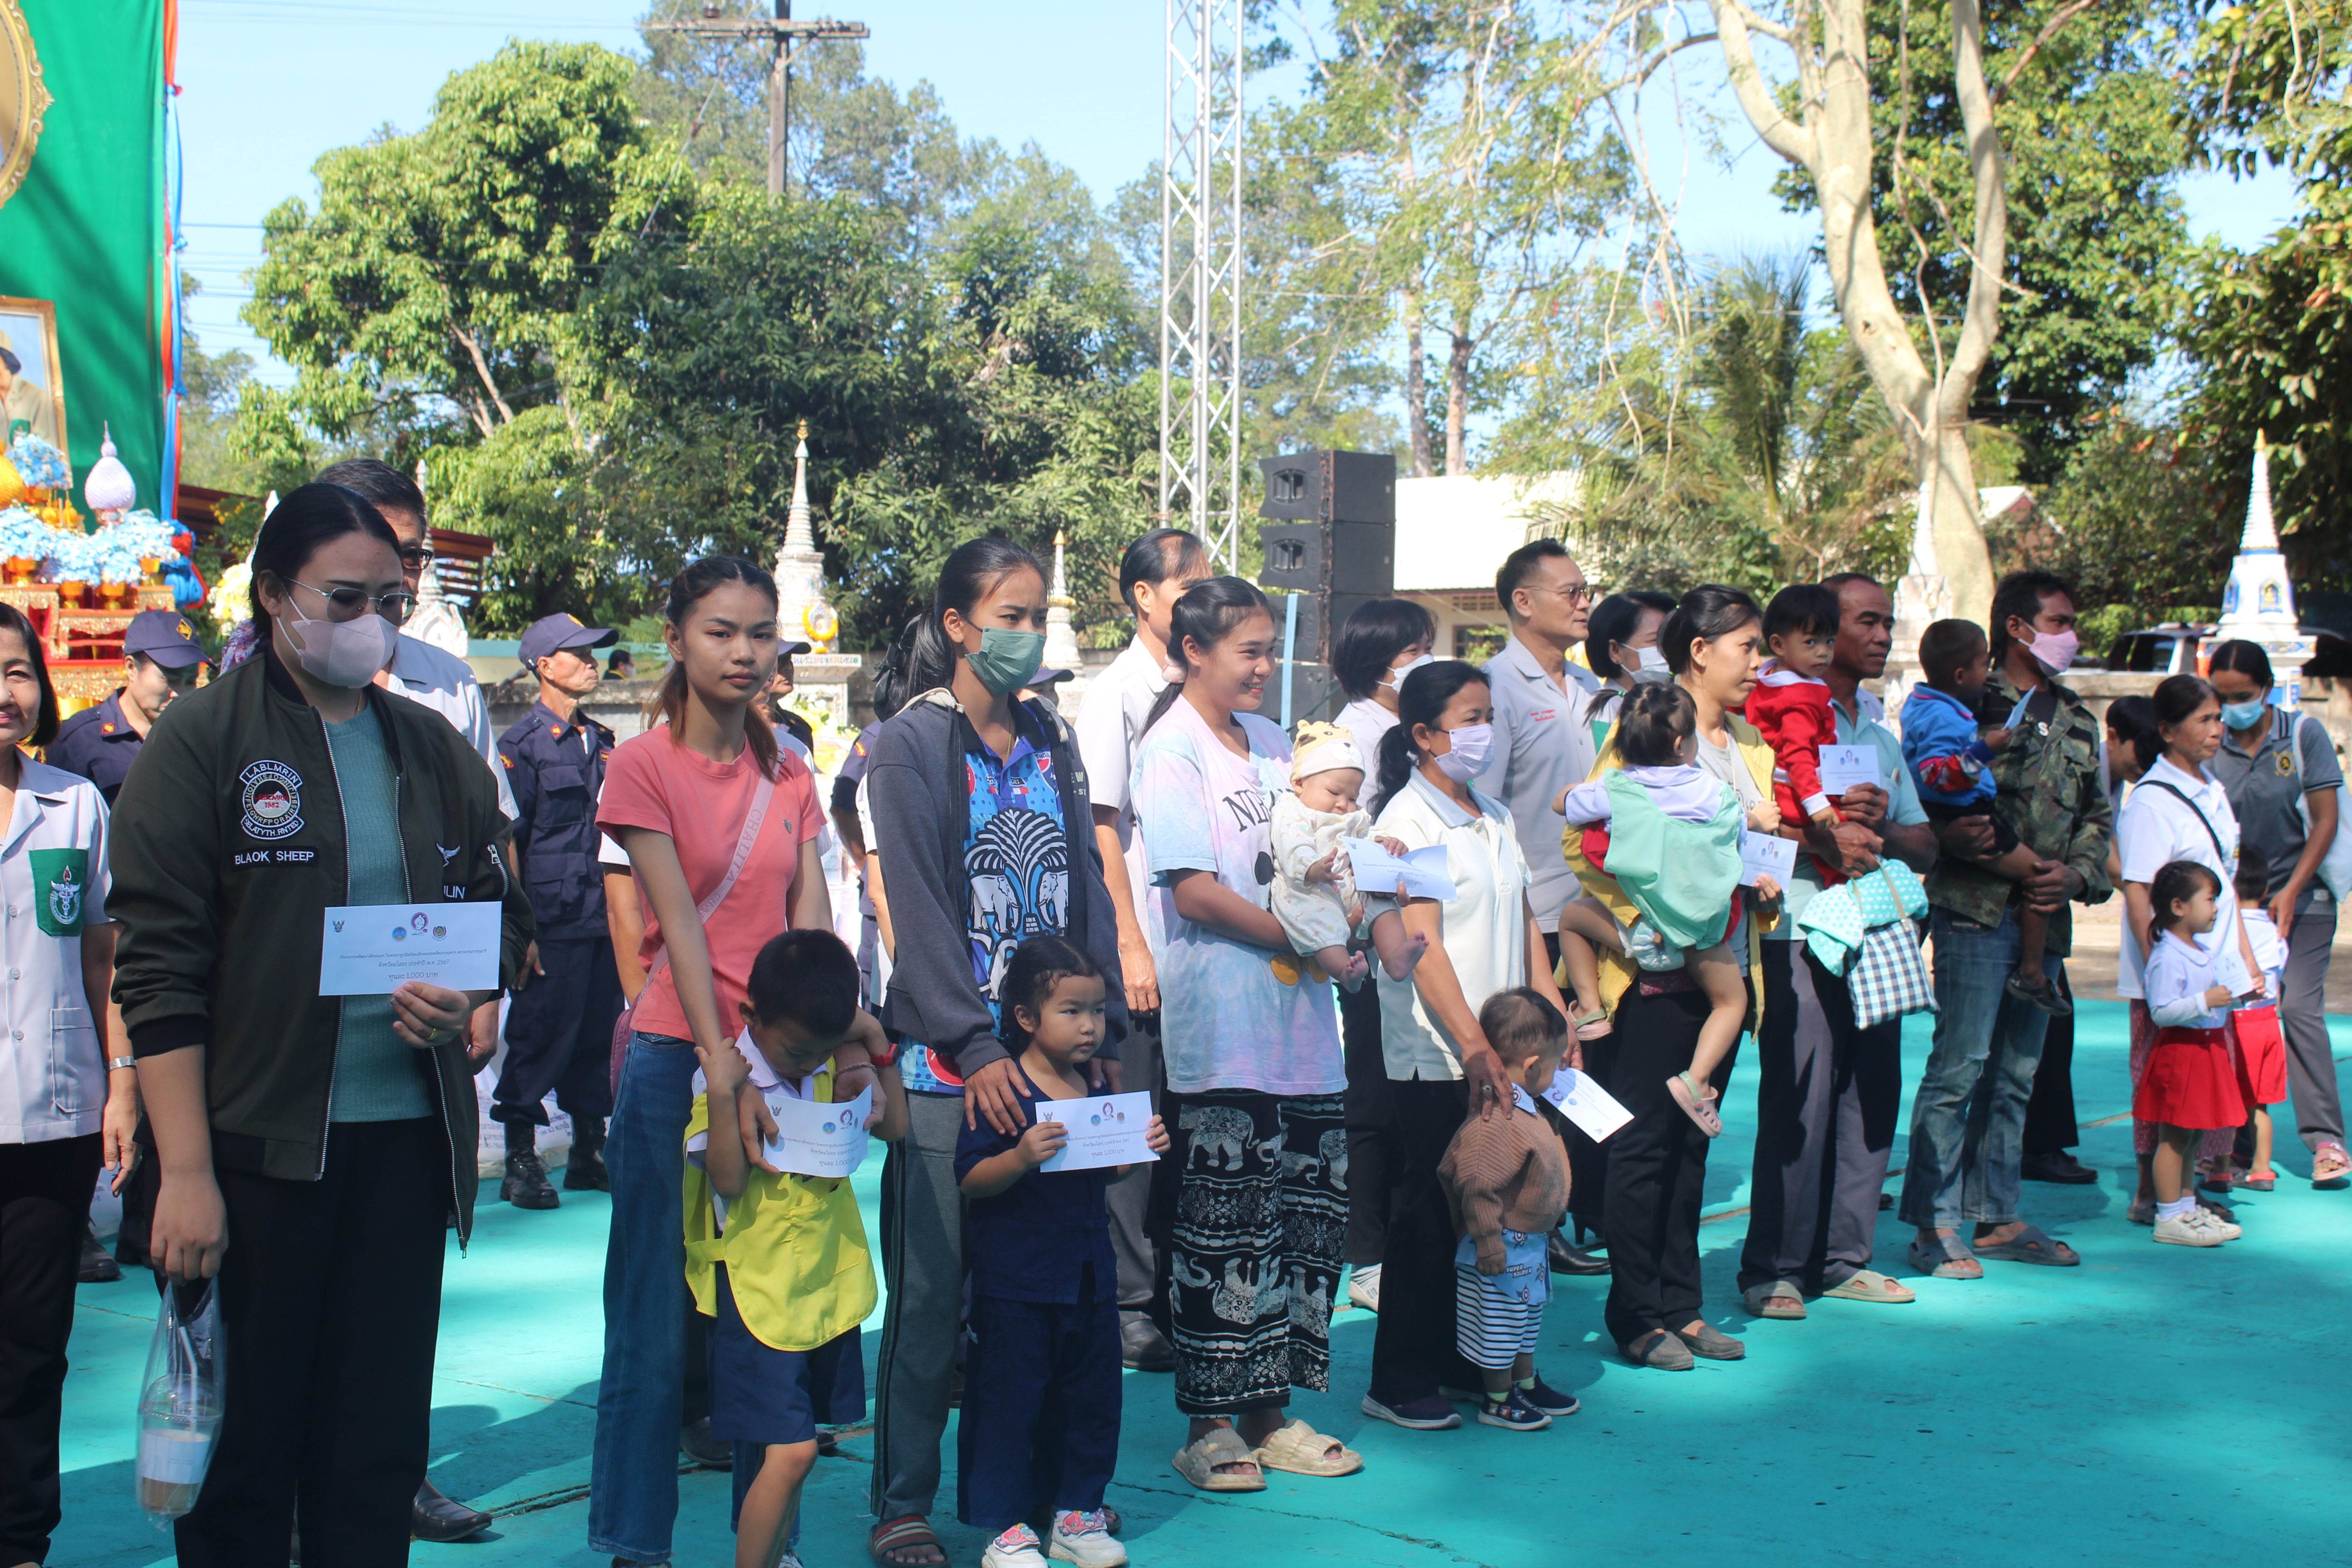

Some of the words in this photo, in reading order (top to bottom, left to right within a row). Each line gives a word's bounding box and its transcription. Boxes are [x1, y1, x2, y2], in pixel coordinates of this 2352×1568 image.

[245, 763, 299, 784] LABLMRIN
[276, 850, 314, 862] SHEEP
[1506, 1264, 1524, 1274] SUPER
[1513, 1268, 1532, 1278] SOLDIER
